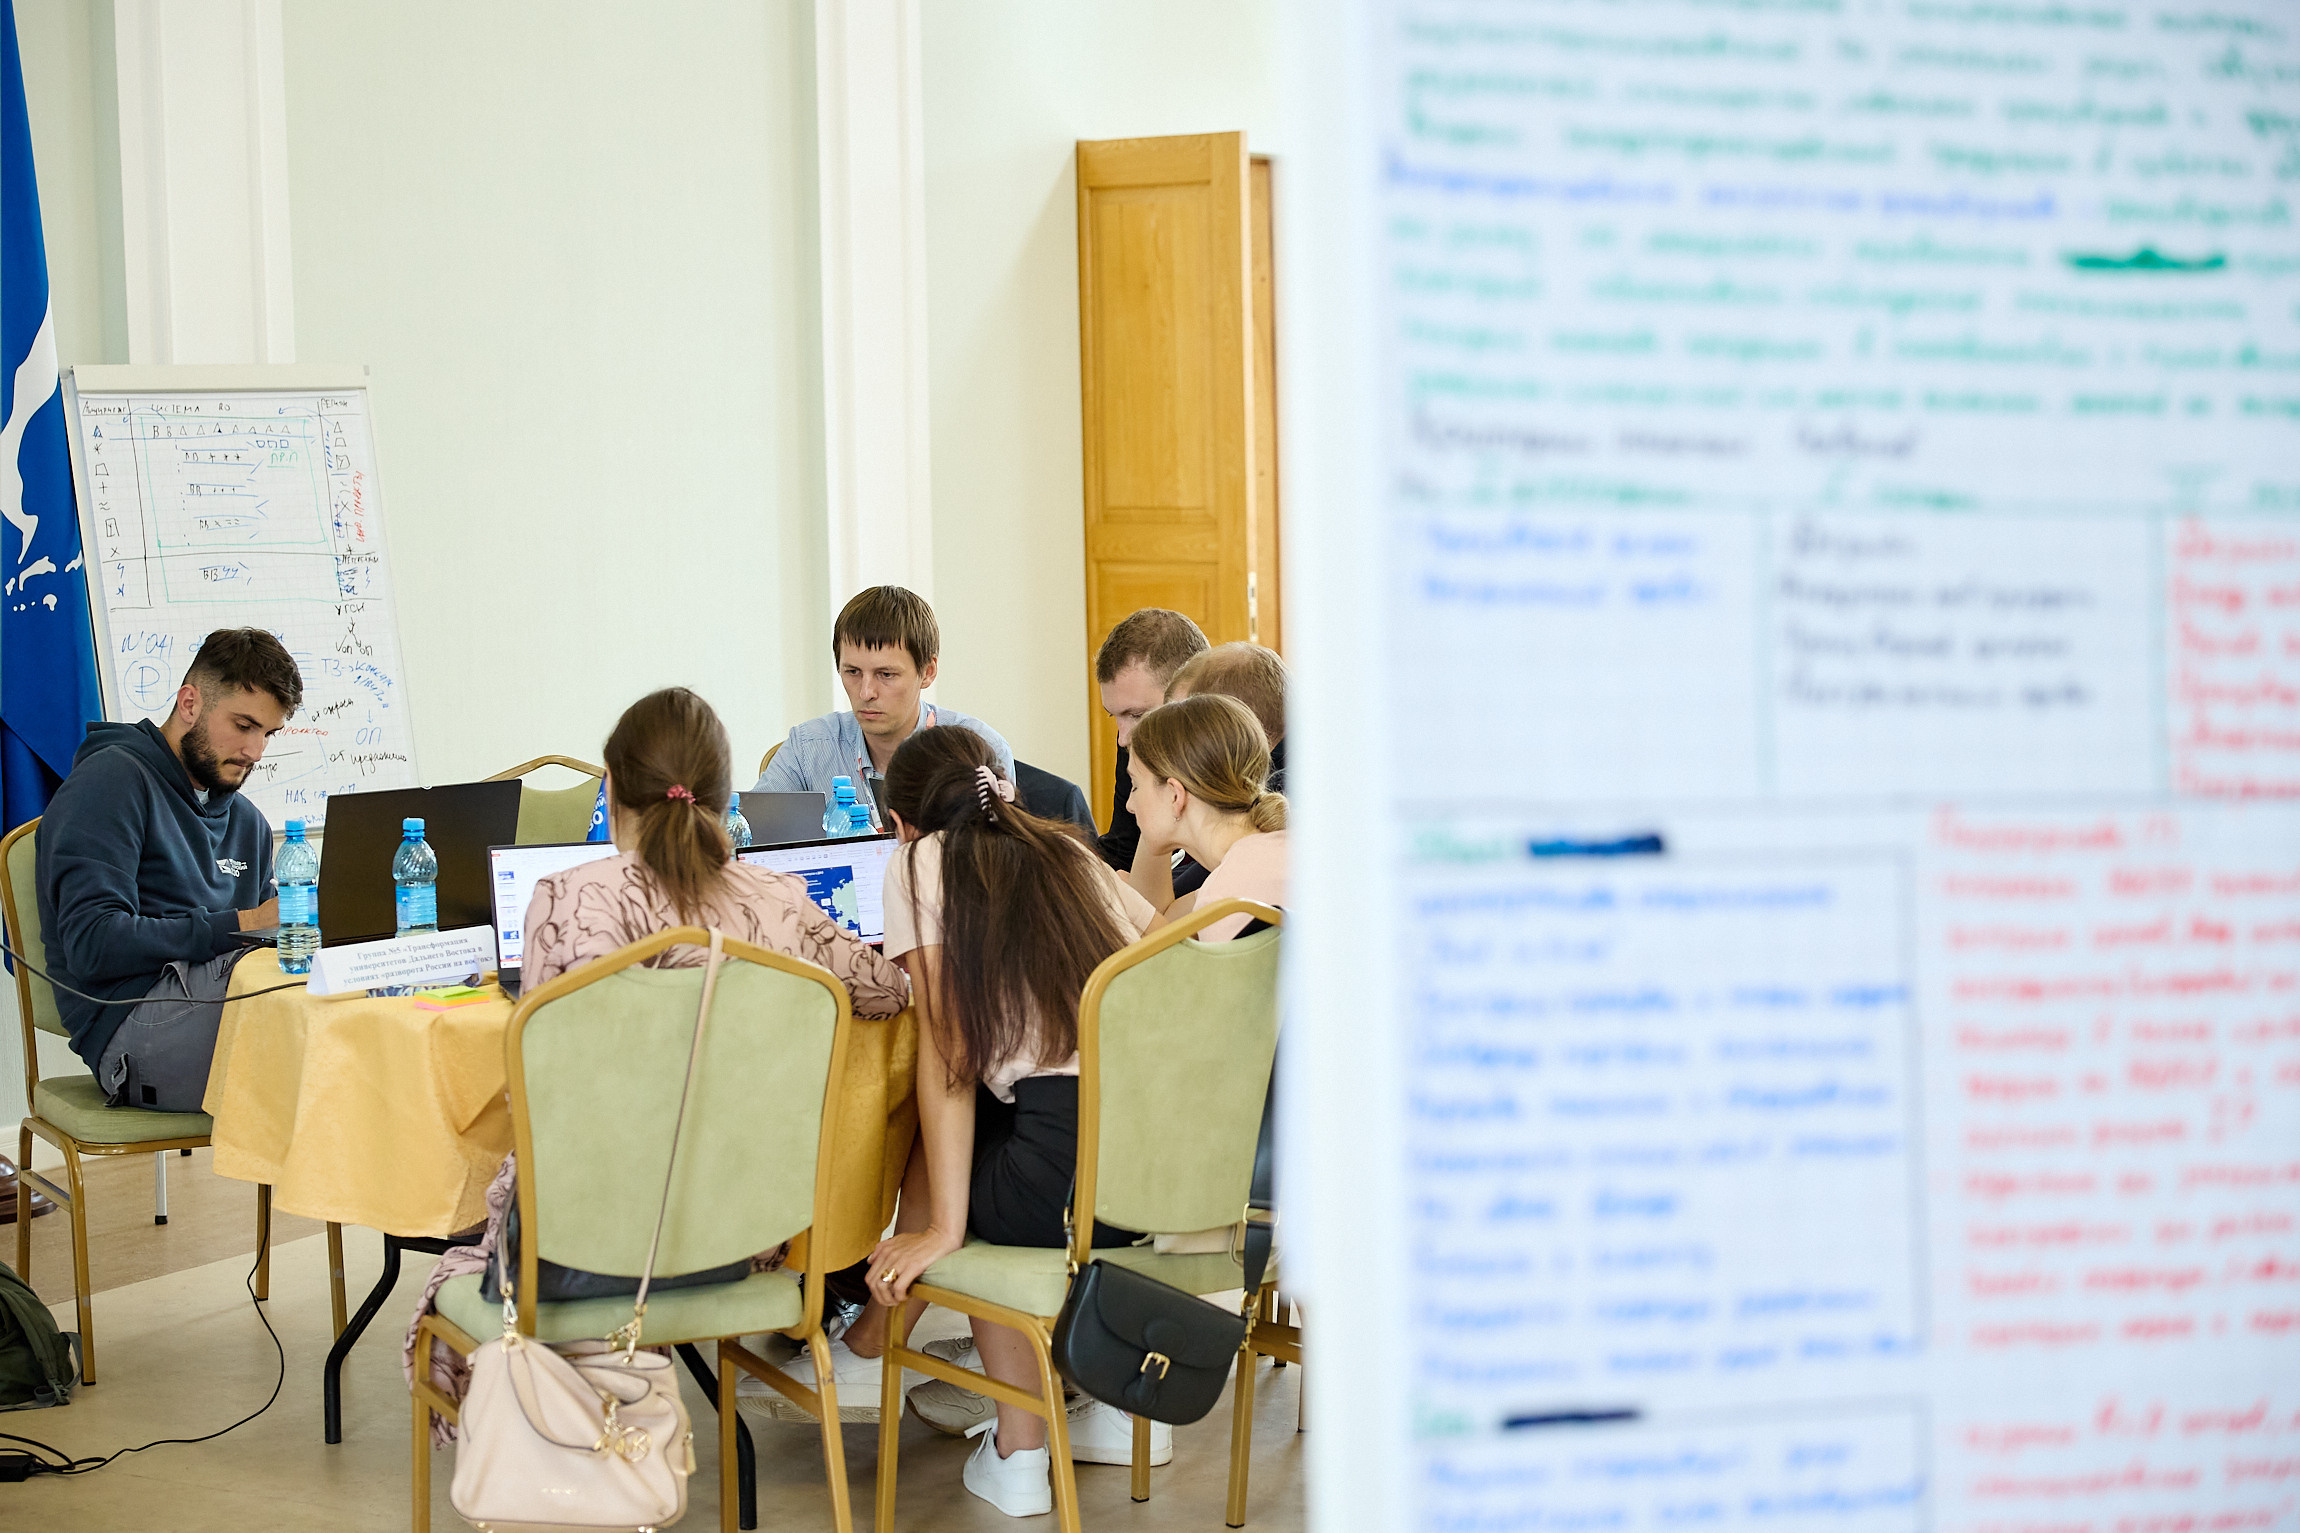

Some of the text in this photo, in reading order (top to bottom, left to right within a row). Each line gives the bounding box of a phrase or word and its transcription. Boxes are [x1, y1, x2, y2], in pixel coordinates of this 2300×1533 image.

[357, 950, 386, 960] Группа
[408, 952, 444, 964] Дальнего
[446, 947, 477, 957] Востока
[425, 961, 452, 972] России
